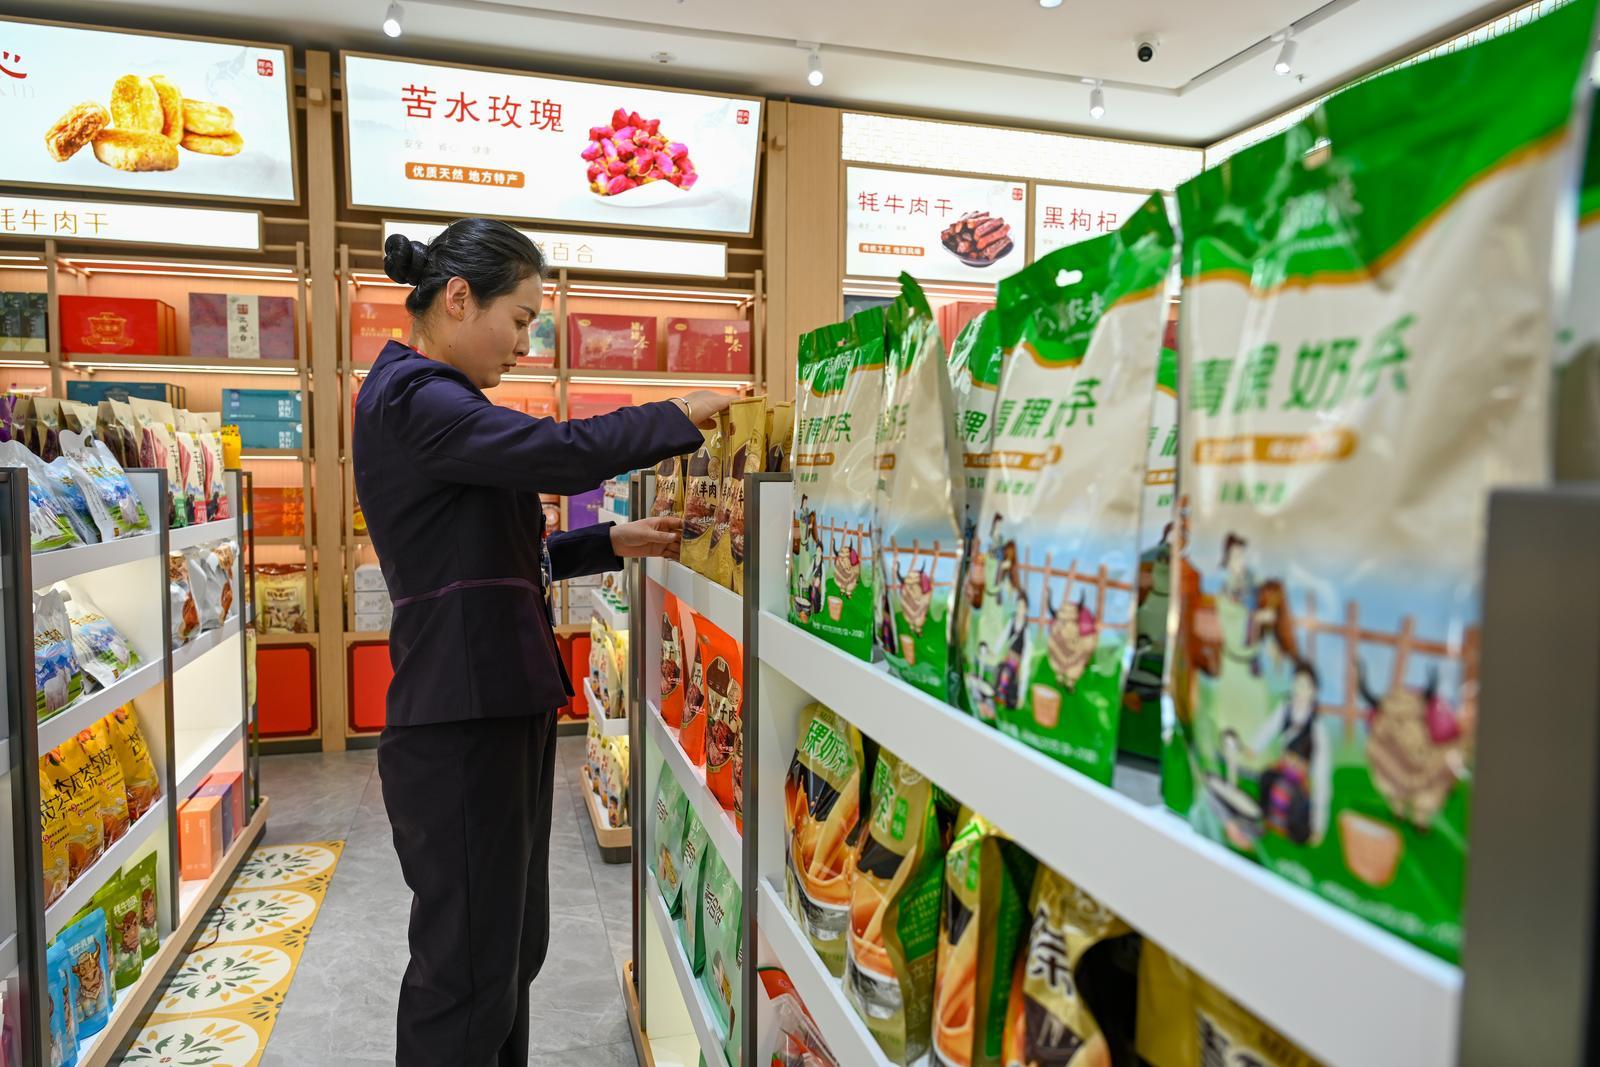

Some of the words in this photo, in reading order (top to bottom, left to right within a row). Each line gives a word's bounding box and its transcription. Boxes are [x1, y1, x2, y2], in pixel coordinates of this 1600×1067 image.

[401, 84, 564, 132] 苦水玫瑰
[412, 165, 464, 181] 优质天然
[468, 170, 518, 185] 地方特产
[858, 190, 953, 217] 牦牛肉干
[1043, 206, 1117, 232] 黑枸杞
[535, 241, 594, 264] 百合
